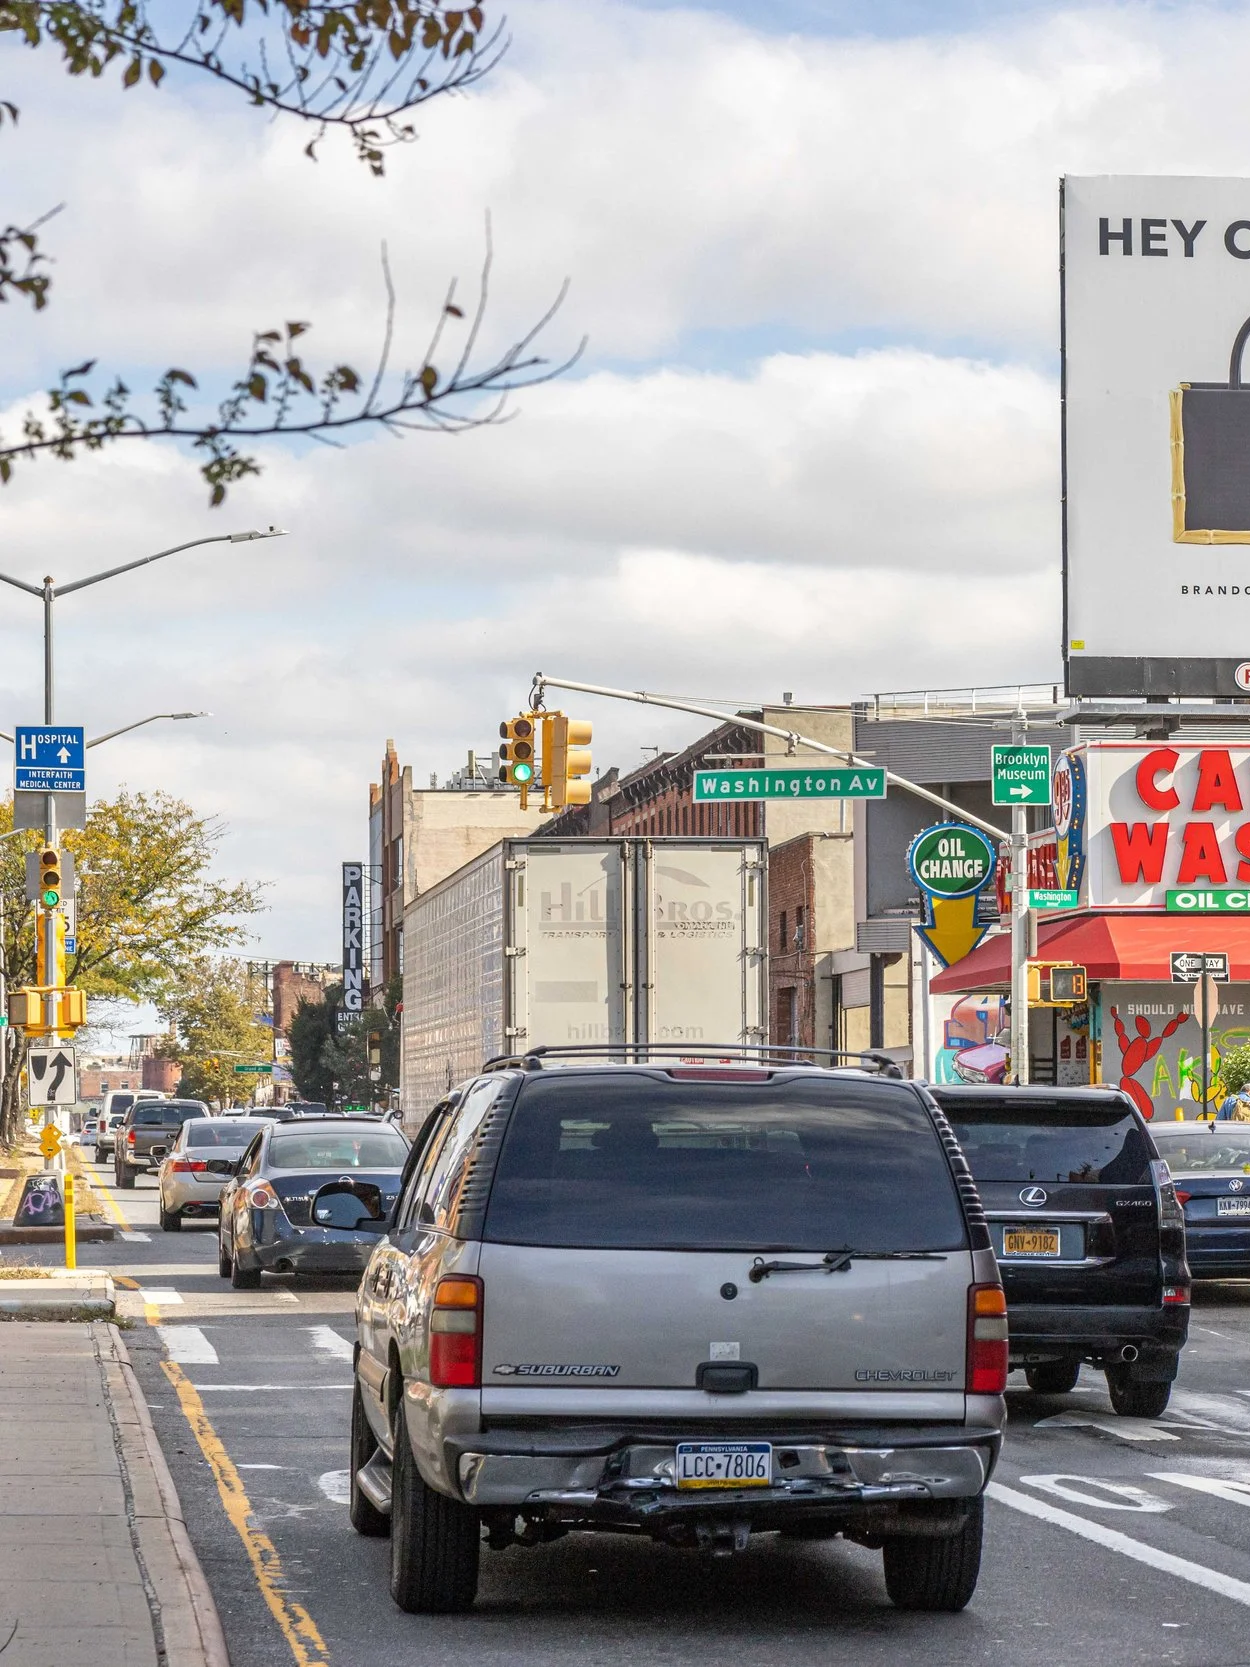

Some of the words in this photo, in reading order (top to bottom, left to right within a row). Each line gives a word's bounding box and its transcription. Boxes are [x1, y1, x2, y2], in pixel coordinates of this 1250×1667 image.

[1099, 217, 1207, 258] HEY
[21, 734, 79, 760] HOSPITAL
[995, 753, 1048, 768] Brooklyn
[28, 770, 73, 779] INTERFAITH
[997, 769, 1046, 780] Museum
[20, 780, 51, 789] MEDICAL
[53, 781, 81, 789] CENTER
[702, 776, 841, 797] Washington
[848, 775, 878, 792] Av
[937, 838, 966, 857] OIL
[919, 859, 984, 880] CHANGE
[1033, 891, 1072, 905] Washington
[1175, 892, 1223, 909] OIL
[344, 866, 362, 1011] PARKING
[1179, 959, 1196, 968] ONE
[1072, 974, 1083, 995] 13
[1127, 1004, 1174, 1015] SHOULD
[515, 1365, 620, 1377] SUBURBAN
[855, 1369, 957, 1381] CHEVROLET
